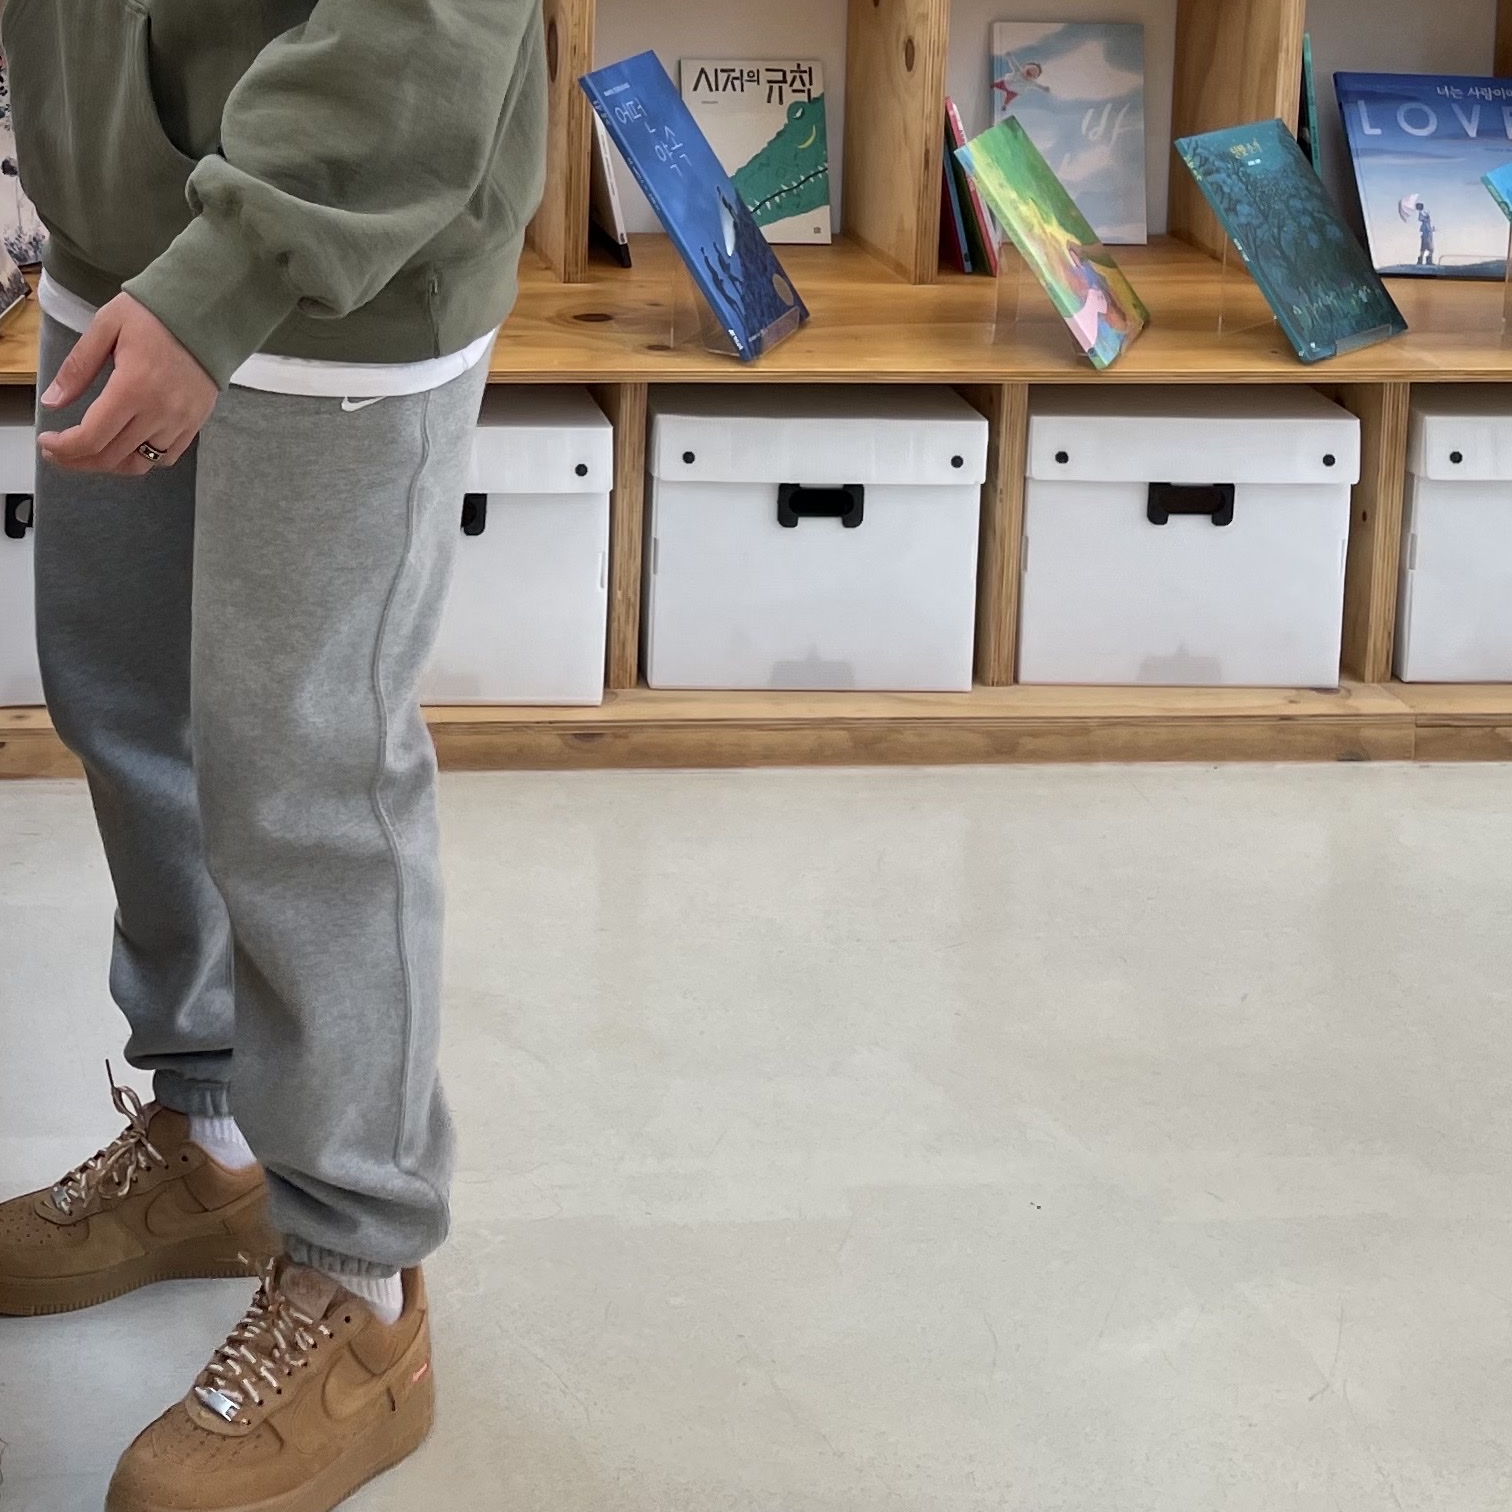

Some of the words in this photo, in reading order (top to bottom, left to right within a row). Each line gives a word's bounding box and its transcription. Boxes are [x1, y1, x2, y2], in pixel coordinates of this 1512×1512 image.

[692, 66, 760, 93] 시저의
[765, 63, 813, 105] 규칙
[1436, 86, 1463, 101] 너는
[614, 96, 656, 134] 어떤
[655, 125, 692, 177] 약속
